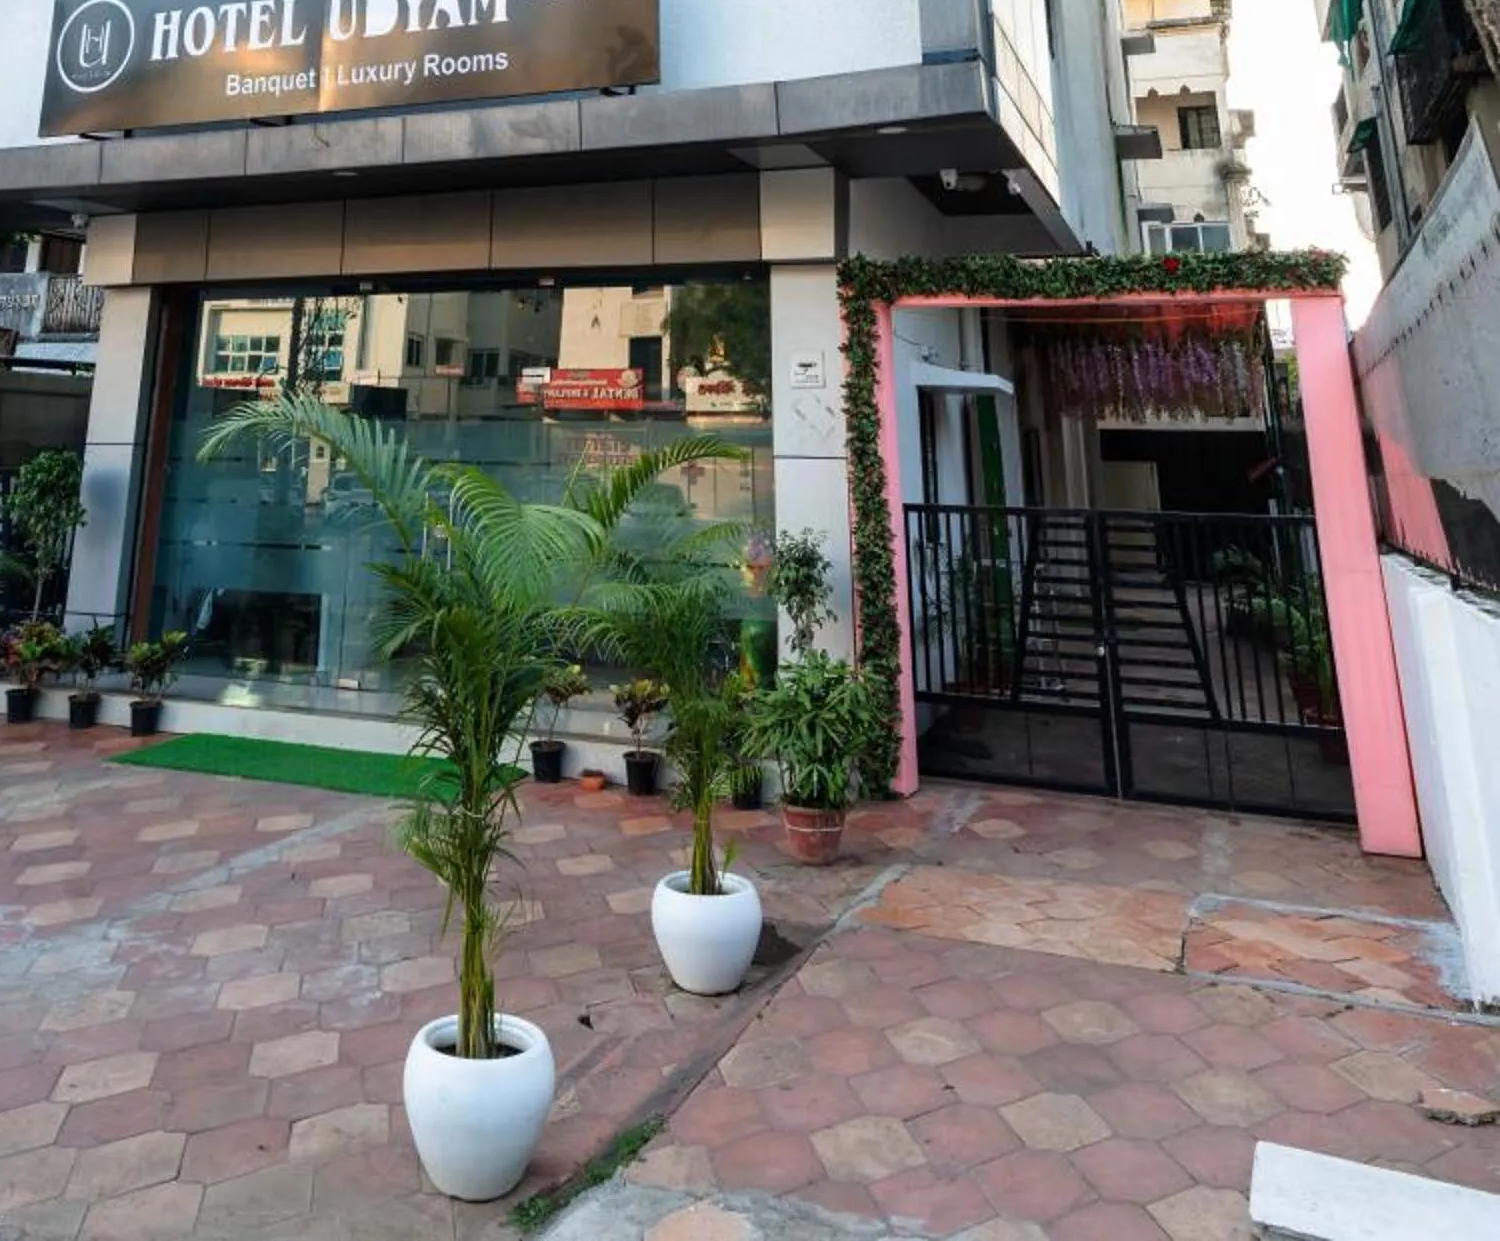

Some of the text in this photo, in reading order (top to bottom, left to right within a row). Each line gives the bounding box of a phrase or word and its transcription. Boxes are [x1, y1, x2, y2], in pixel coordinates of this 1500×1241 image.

[225, 51, 509, 97] Banquet Luxury Rooms
